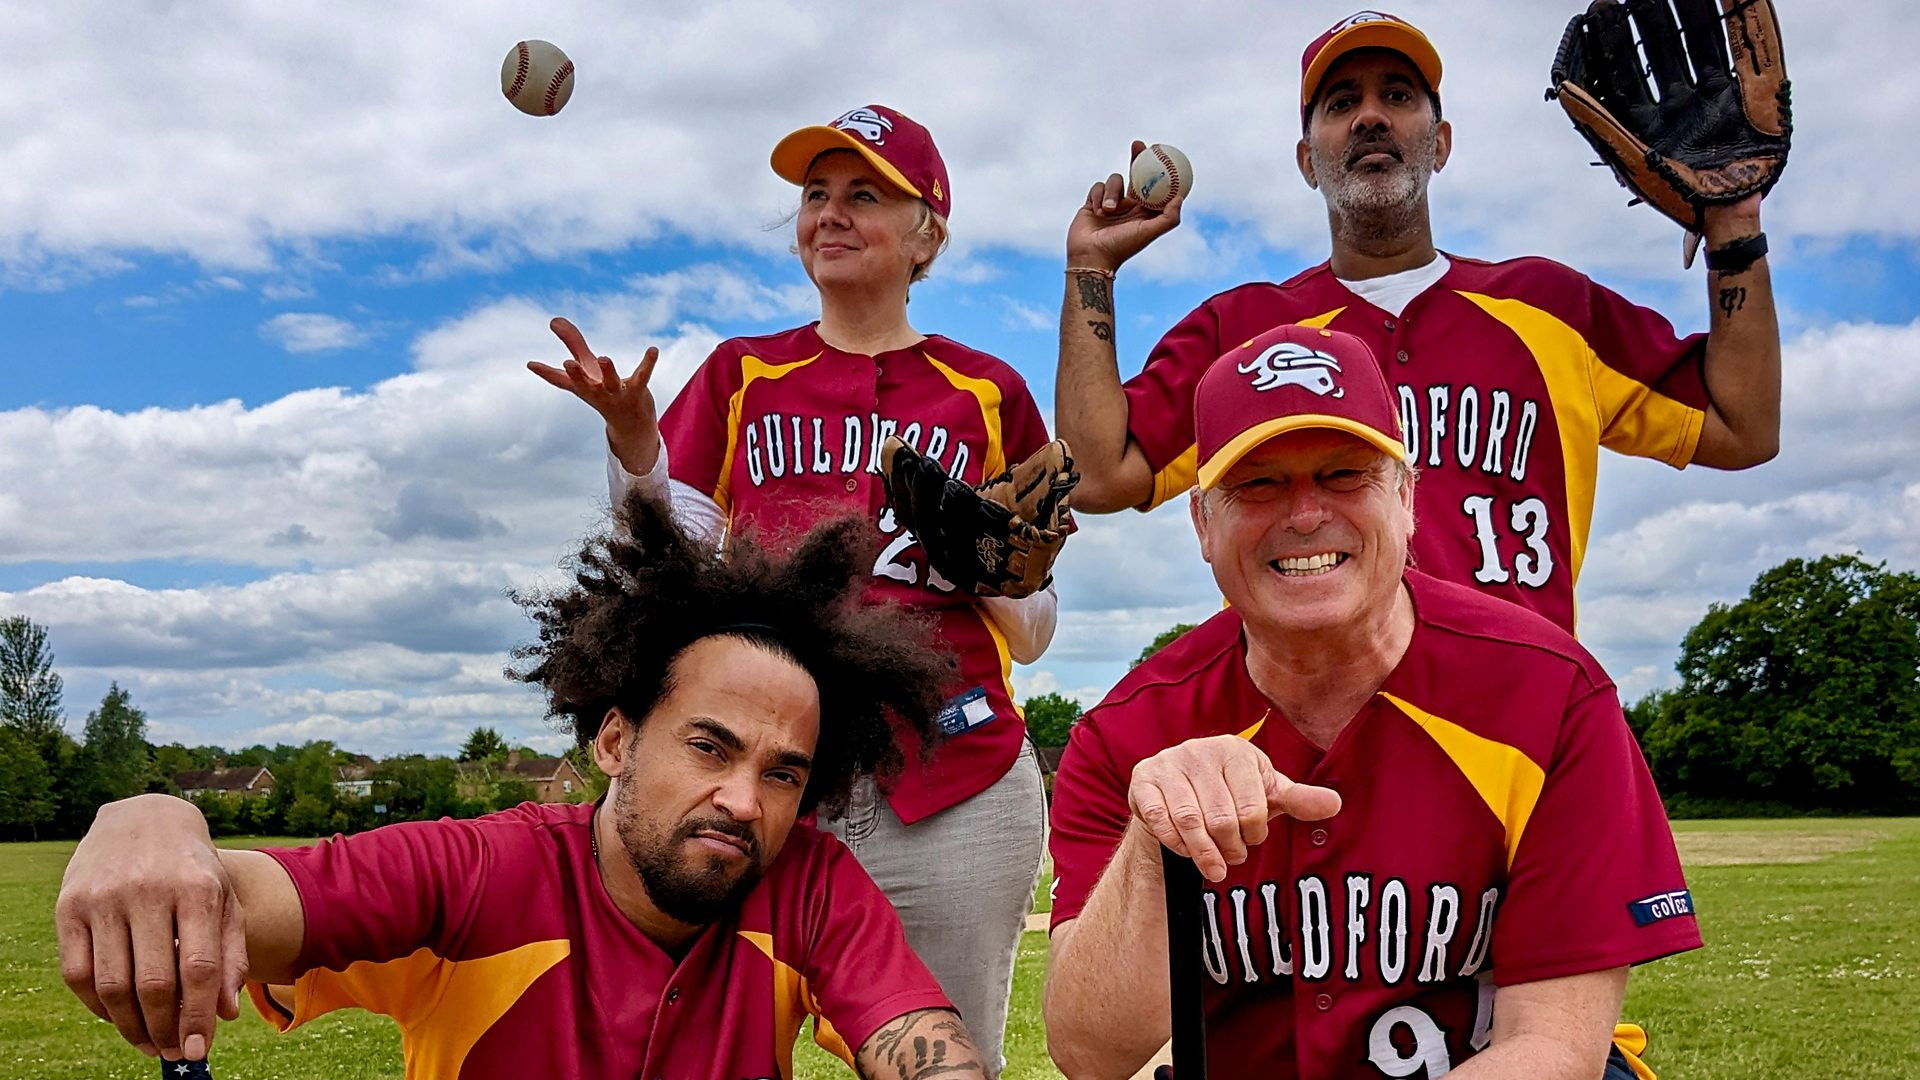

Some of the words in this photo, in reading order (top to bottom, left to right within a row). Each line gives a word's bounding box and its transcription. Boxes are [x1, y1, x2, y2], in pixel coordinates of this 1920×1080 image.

[1397, 384, 1537, 482] DFORD
[871, 507, 957, 592] 2
[1463, 494, 1555, 589] 13
[1202, 875, 1499, 985] UILDFORD
